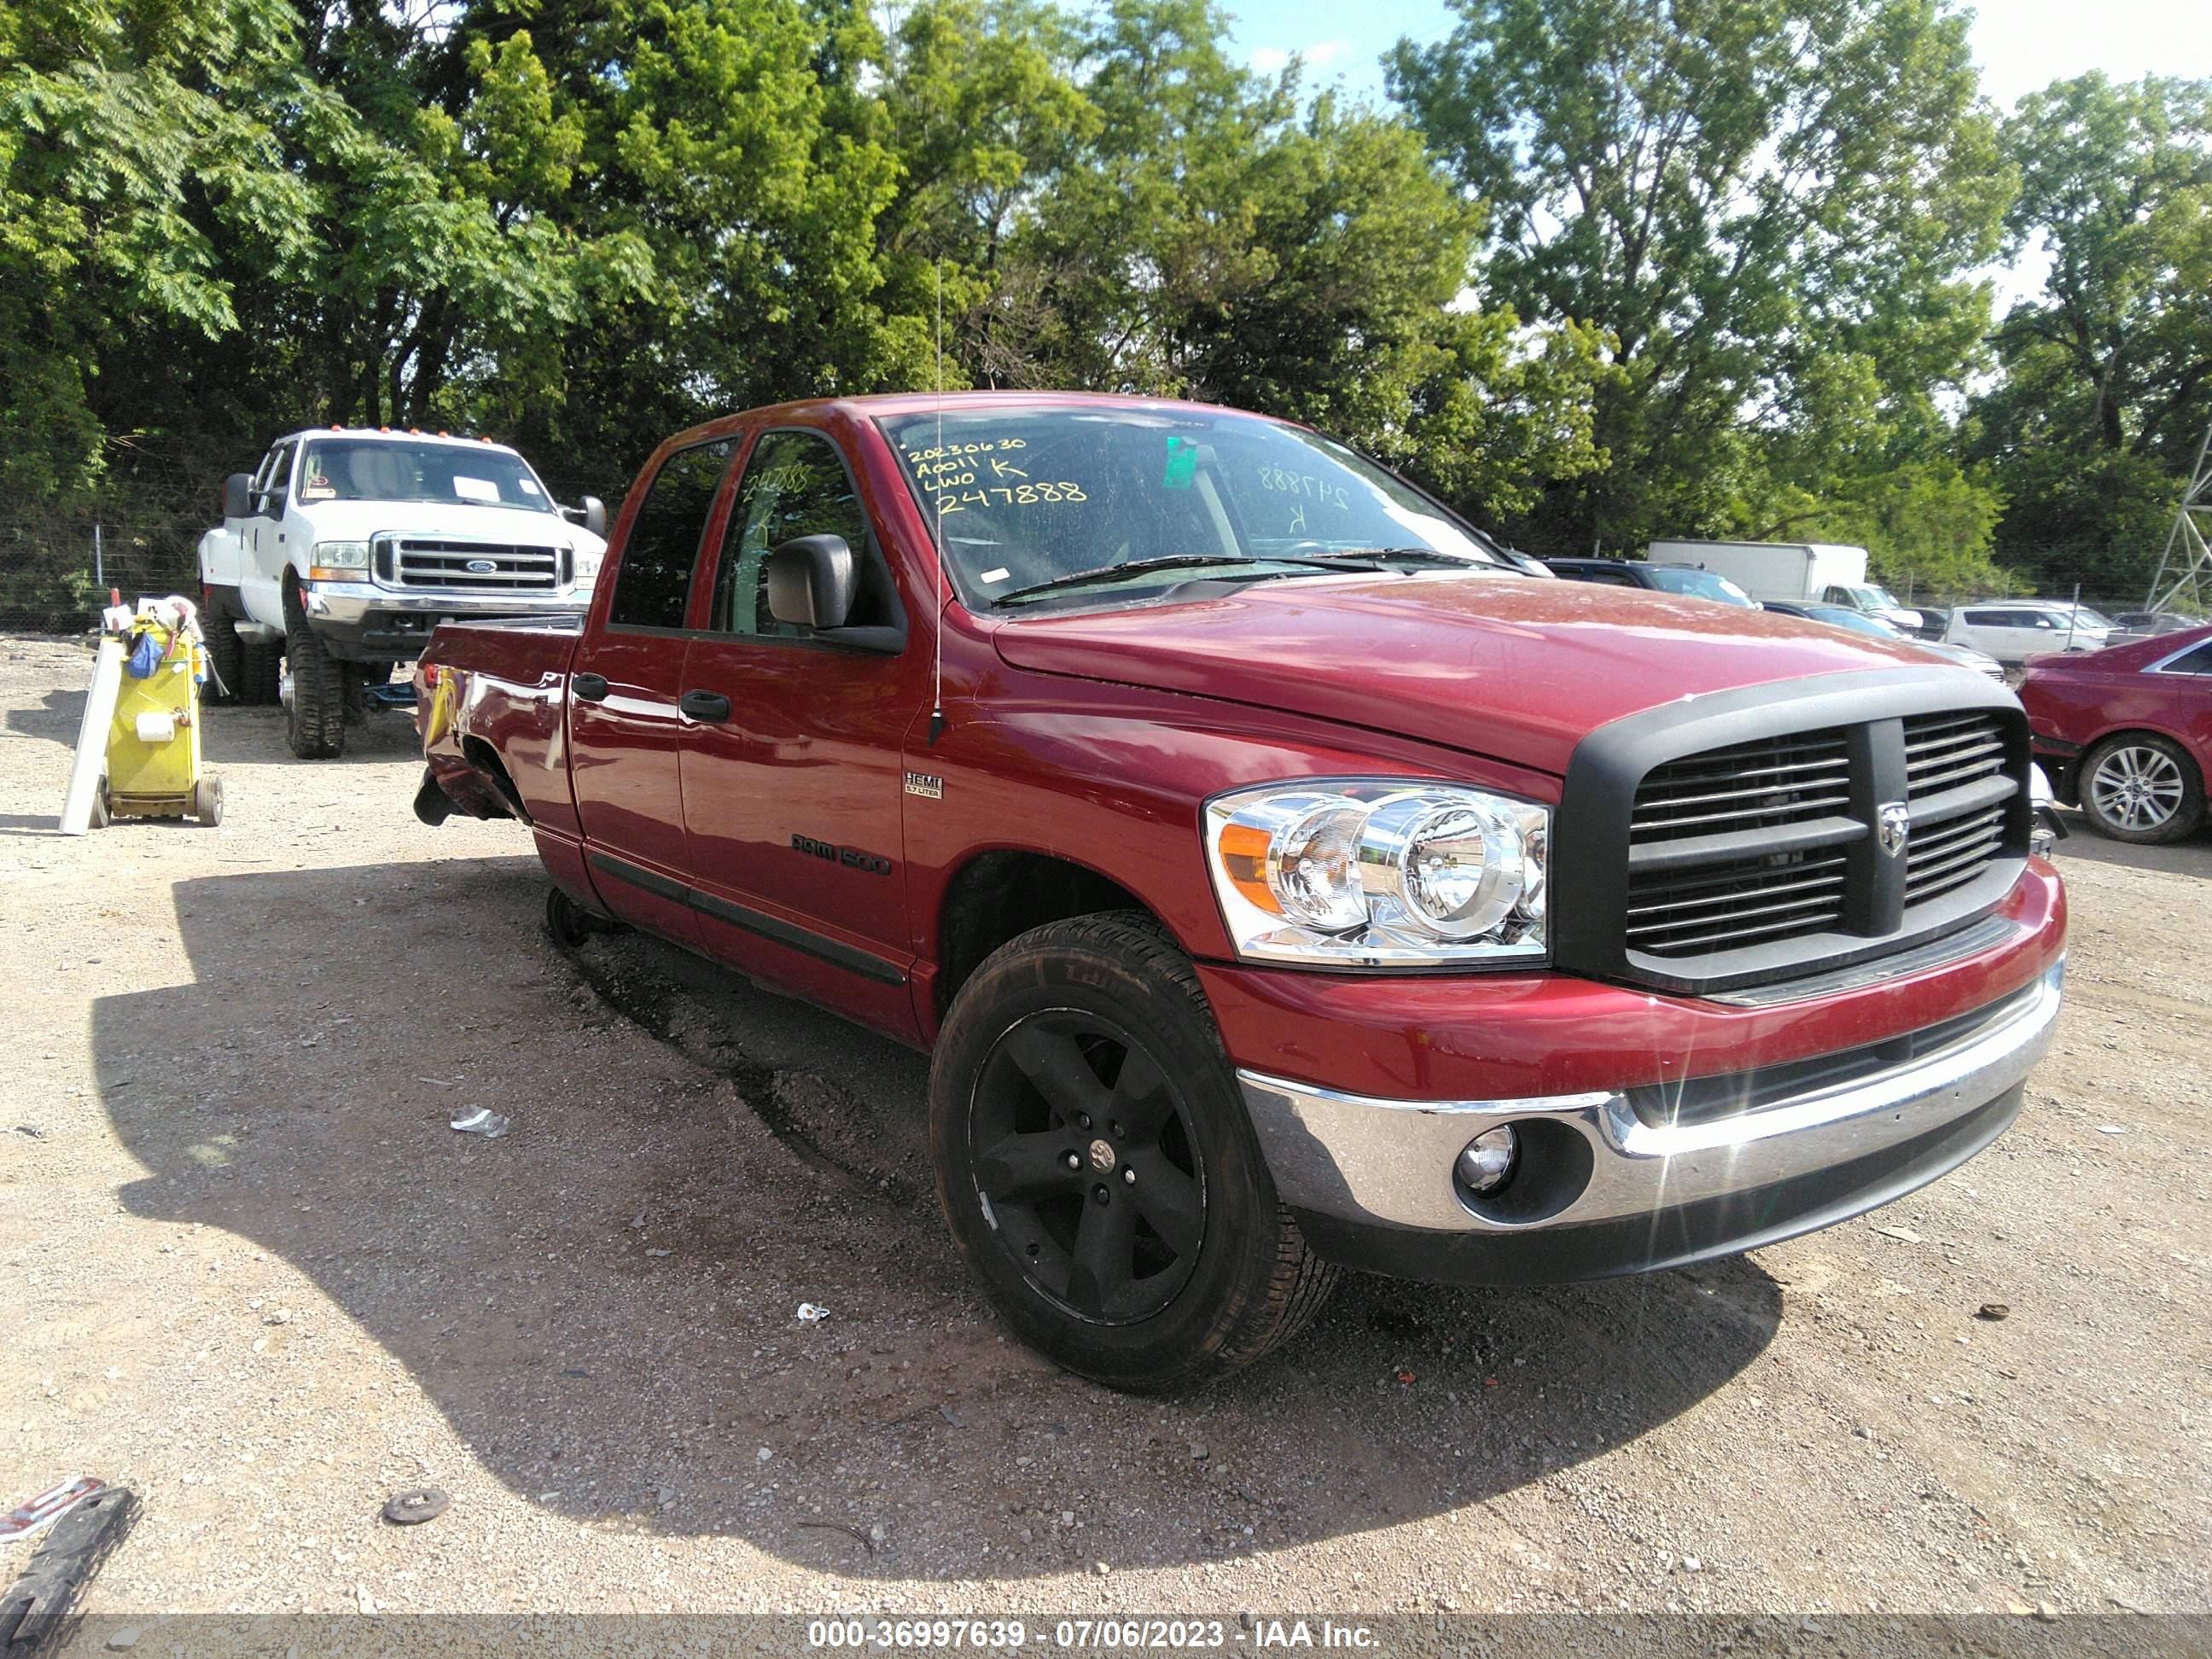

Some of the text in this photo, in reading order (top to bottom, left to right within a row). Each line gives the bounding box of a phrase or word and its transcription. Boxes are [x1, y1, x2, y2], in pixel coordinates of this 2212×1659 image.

[991, 458, 1028, 477] K
[935, 481, 1087, 515] 247888
[905, 772, 939, 788] HEMI
[918, 788, 939, 796] LITER
[840, 847, 891, 875] 1500
